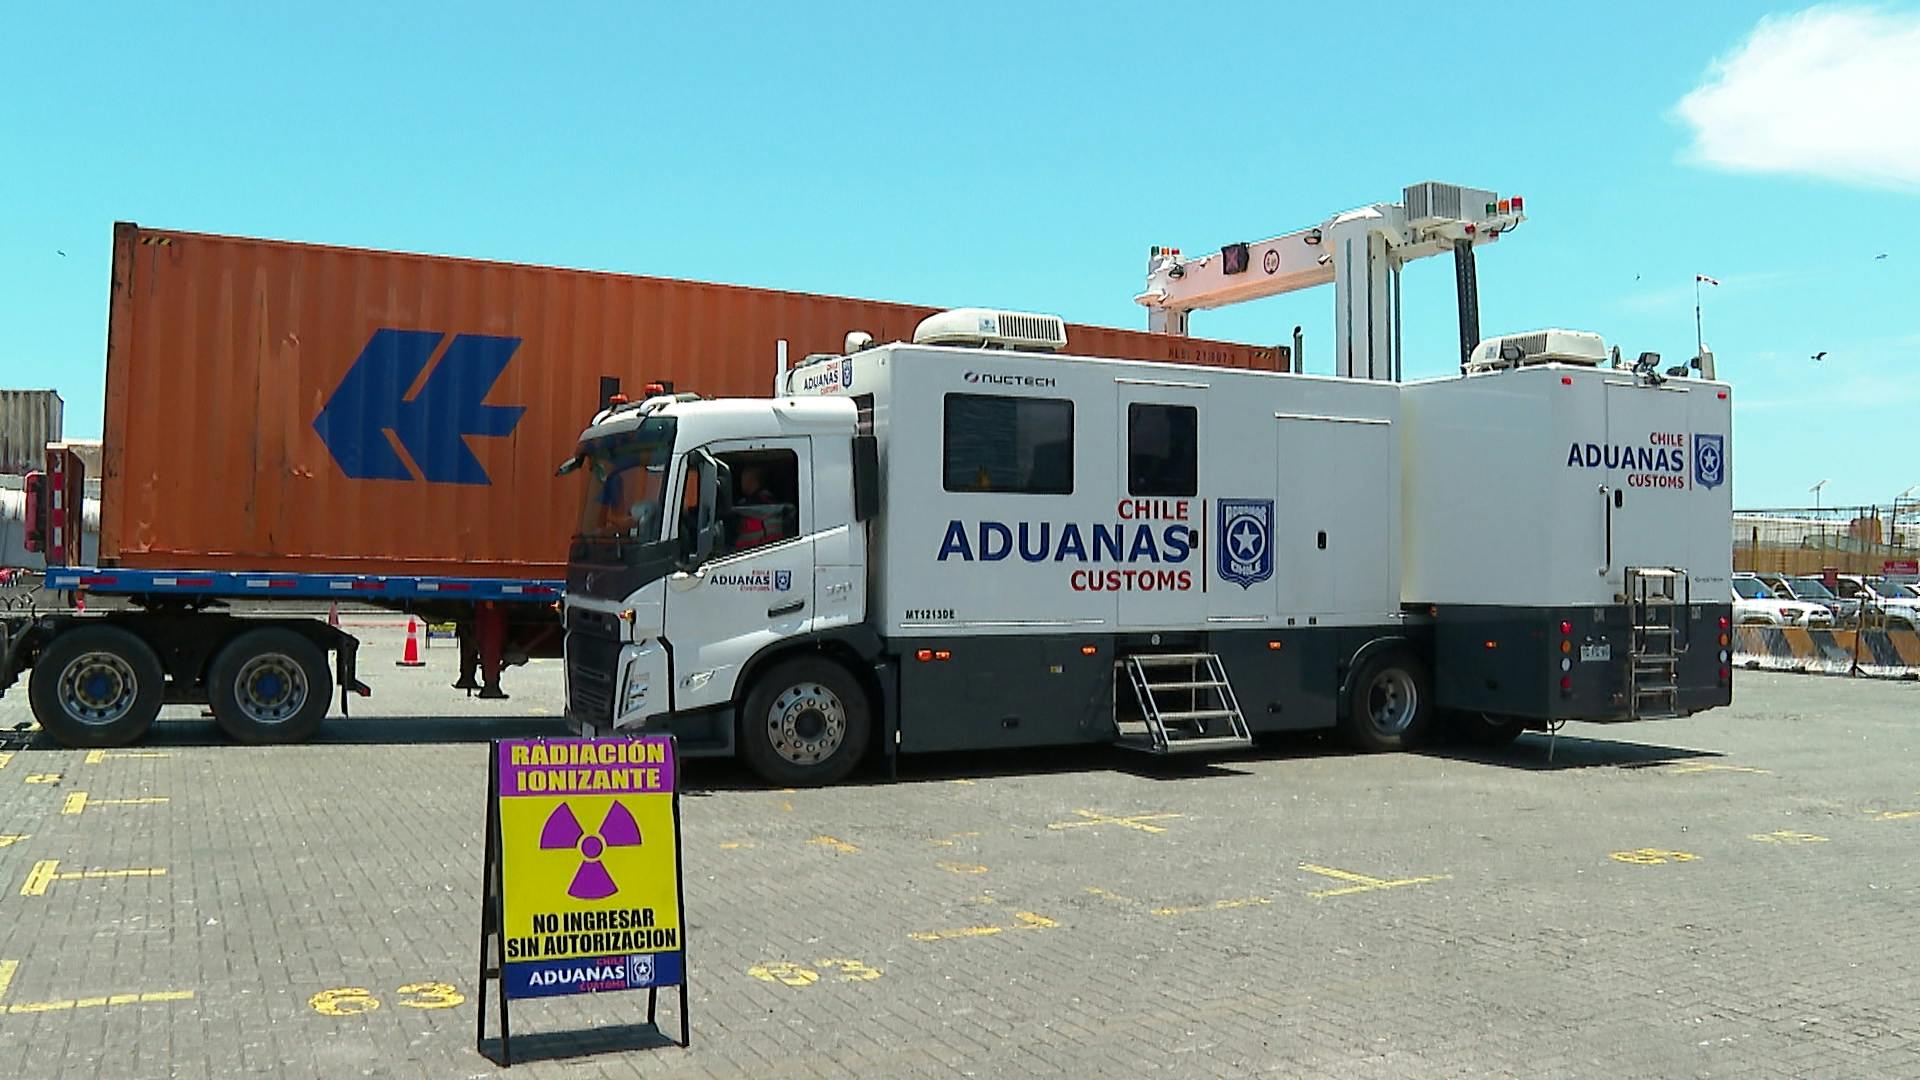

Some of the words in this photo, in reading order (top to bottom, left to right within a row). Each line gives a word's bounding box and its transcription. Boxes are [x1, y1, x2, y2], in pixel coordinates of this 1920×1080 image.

[803, 370, 838, 391] ADUANAS
[982, 374, 1055, 387] NUCTECH
[1650, 432, 1684, 447] CHILE
[1567, 442, 1684, 472] ADUANAS
[1627, 474, 1684, 489] CUSTOMS
[1118, 500, 1188, 520] CHILE
[937, 520, 1190, 563] ADUANAS
[710, 575, 770, 585] ADUANAS
[1071, 570, 1192, 591] CUSTOMS
[511, 740, 665, 766] RADIACIÓN
[517, 768, 661, 792] IONIZANTE
[533, 913, 559, 935] NO
[563, 908, 655, 933] INGRESAR
[507, 936, 540, 958] SIN
[543, 927, 677, 956] AUTORIZACION
[529, 965, 625, 987] ADUANAS
